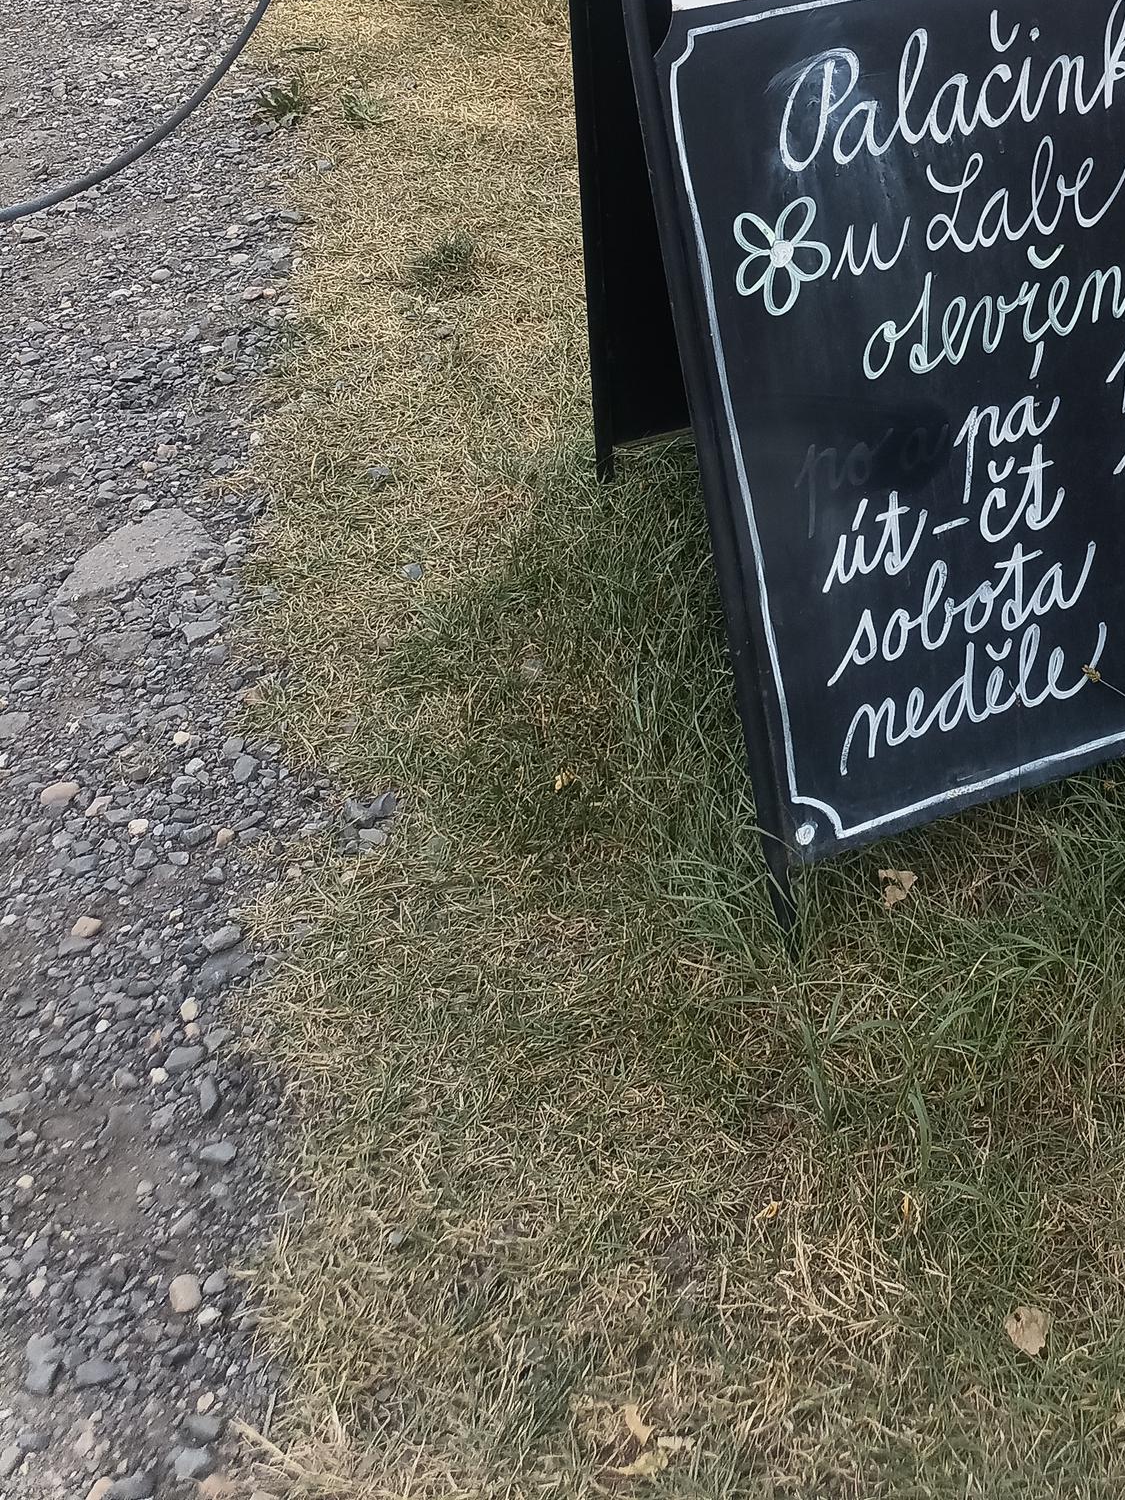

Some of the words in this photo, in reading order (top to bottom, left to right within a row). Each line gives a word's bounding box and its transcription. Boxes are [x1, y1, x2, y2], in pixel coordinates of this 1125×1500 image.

[832, 215, 911, 280] u
[827, 540, 1097, 687] sobota
[840, 621, 1108, 776] neděle
